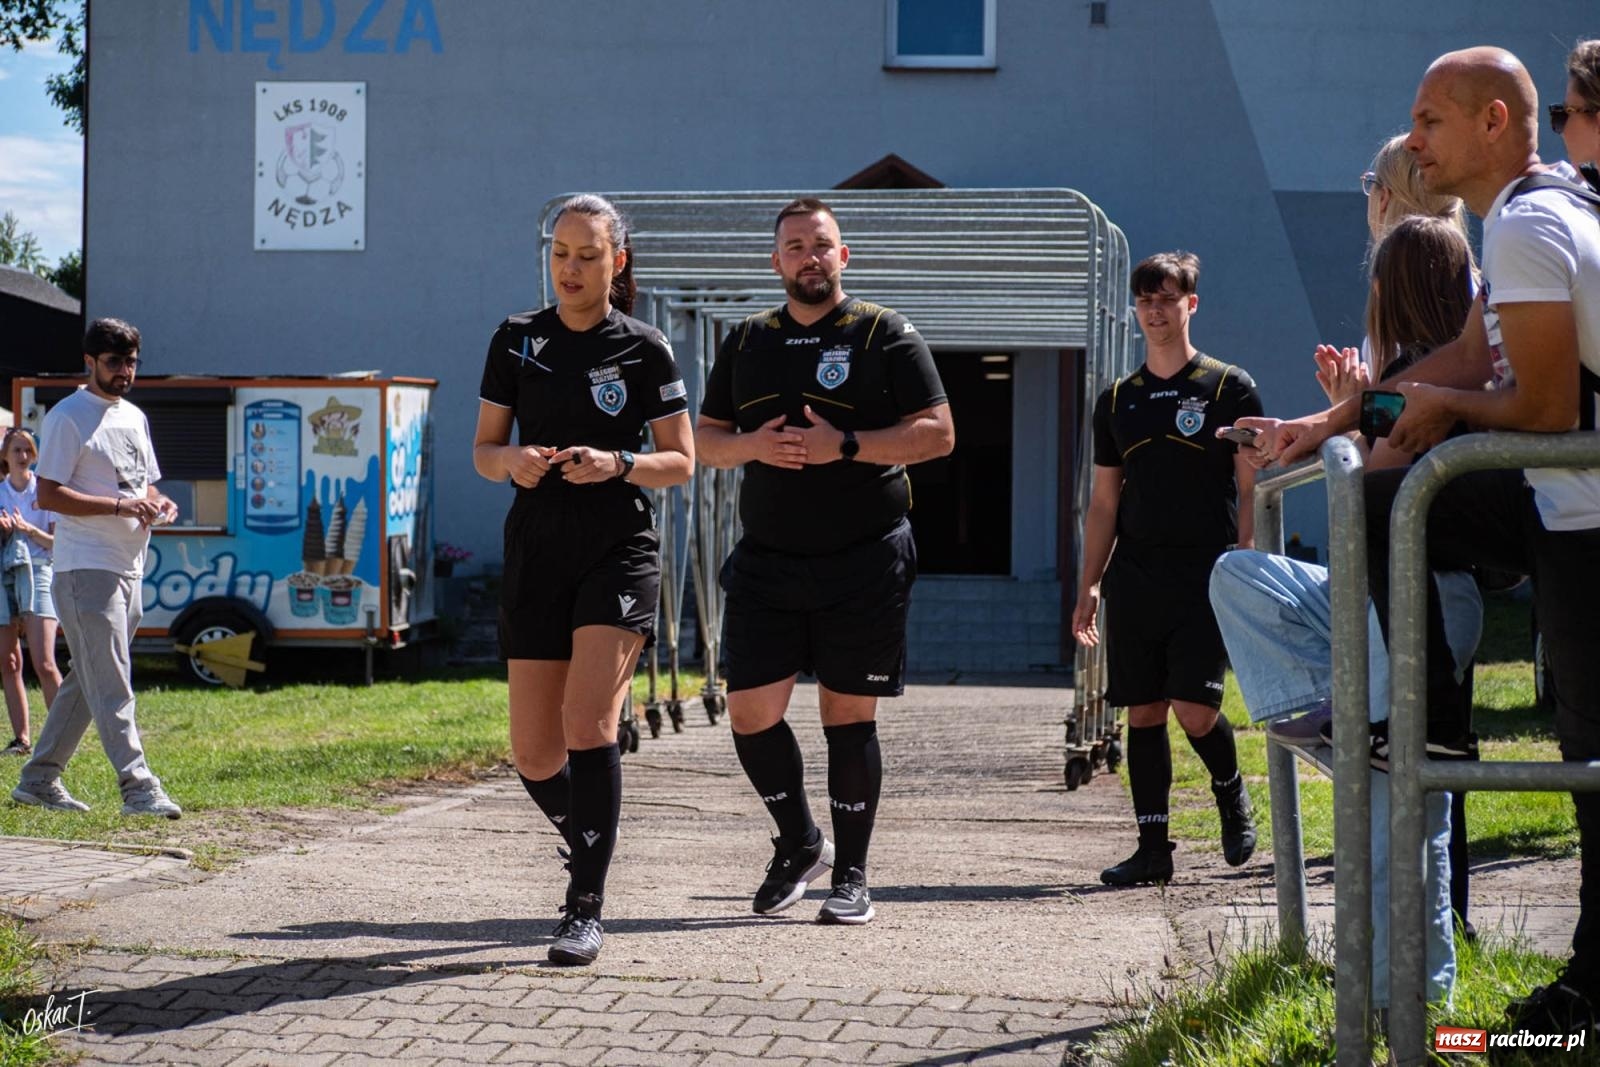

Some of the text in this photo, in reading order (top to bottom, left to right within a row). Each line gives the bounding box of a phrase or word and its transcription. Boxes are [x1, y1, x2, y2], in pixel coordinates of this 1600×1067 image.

[188, 0, 444, 71] NĘDZA
[274, 99, 348, 122] LKS 1908
[267, 198, 353, 229] NĘDZA
[829, 799, 866, 812] ina
